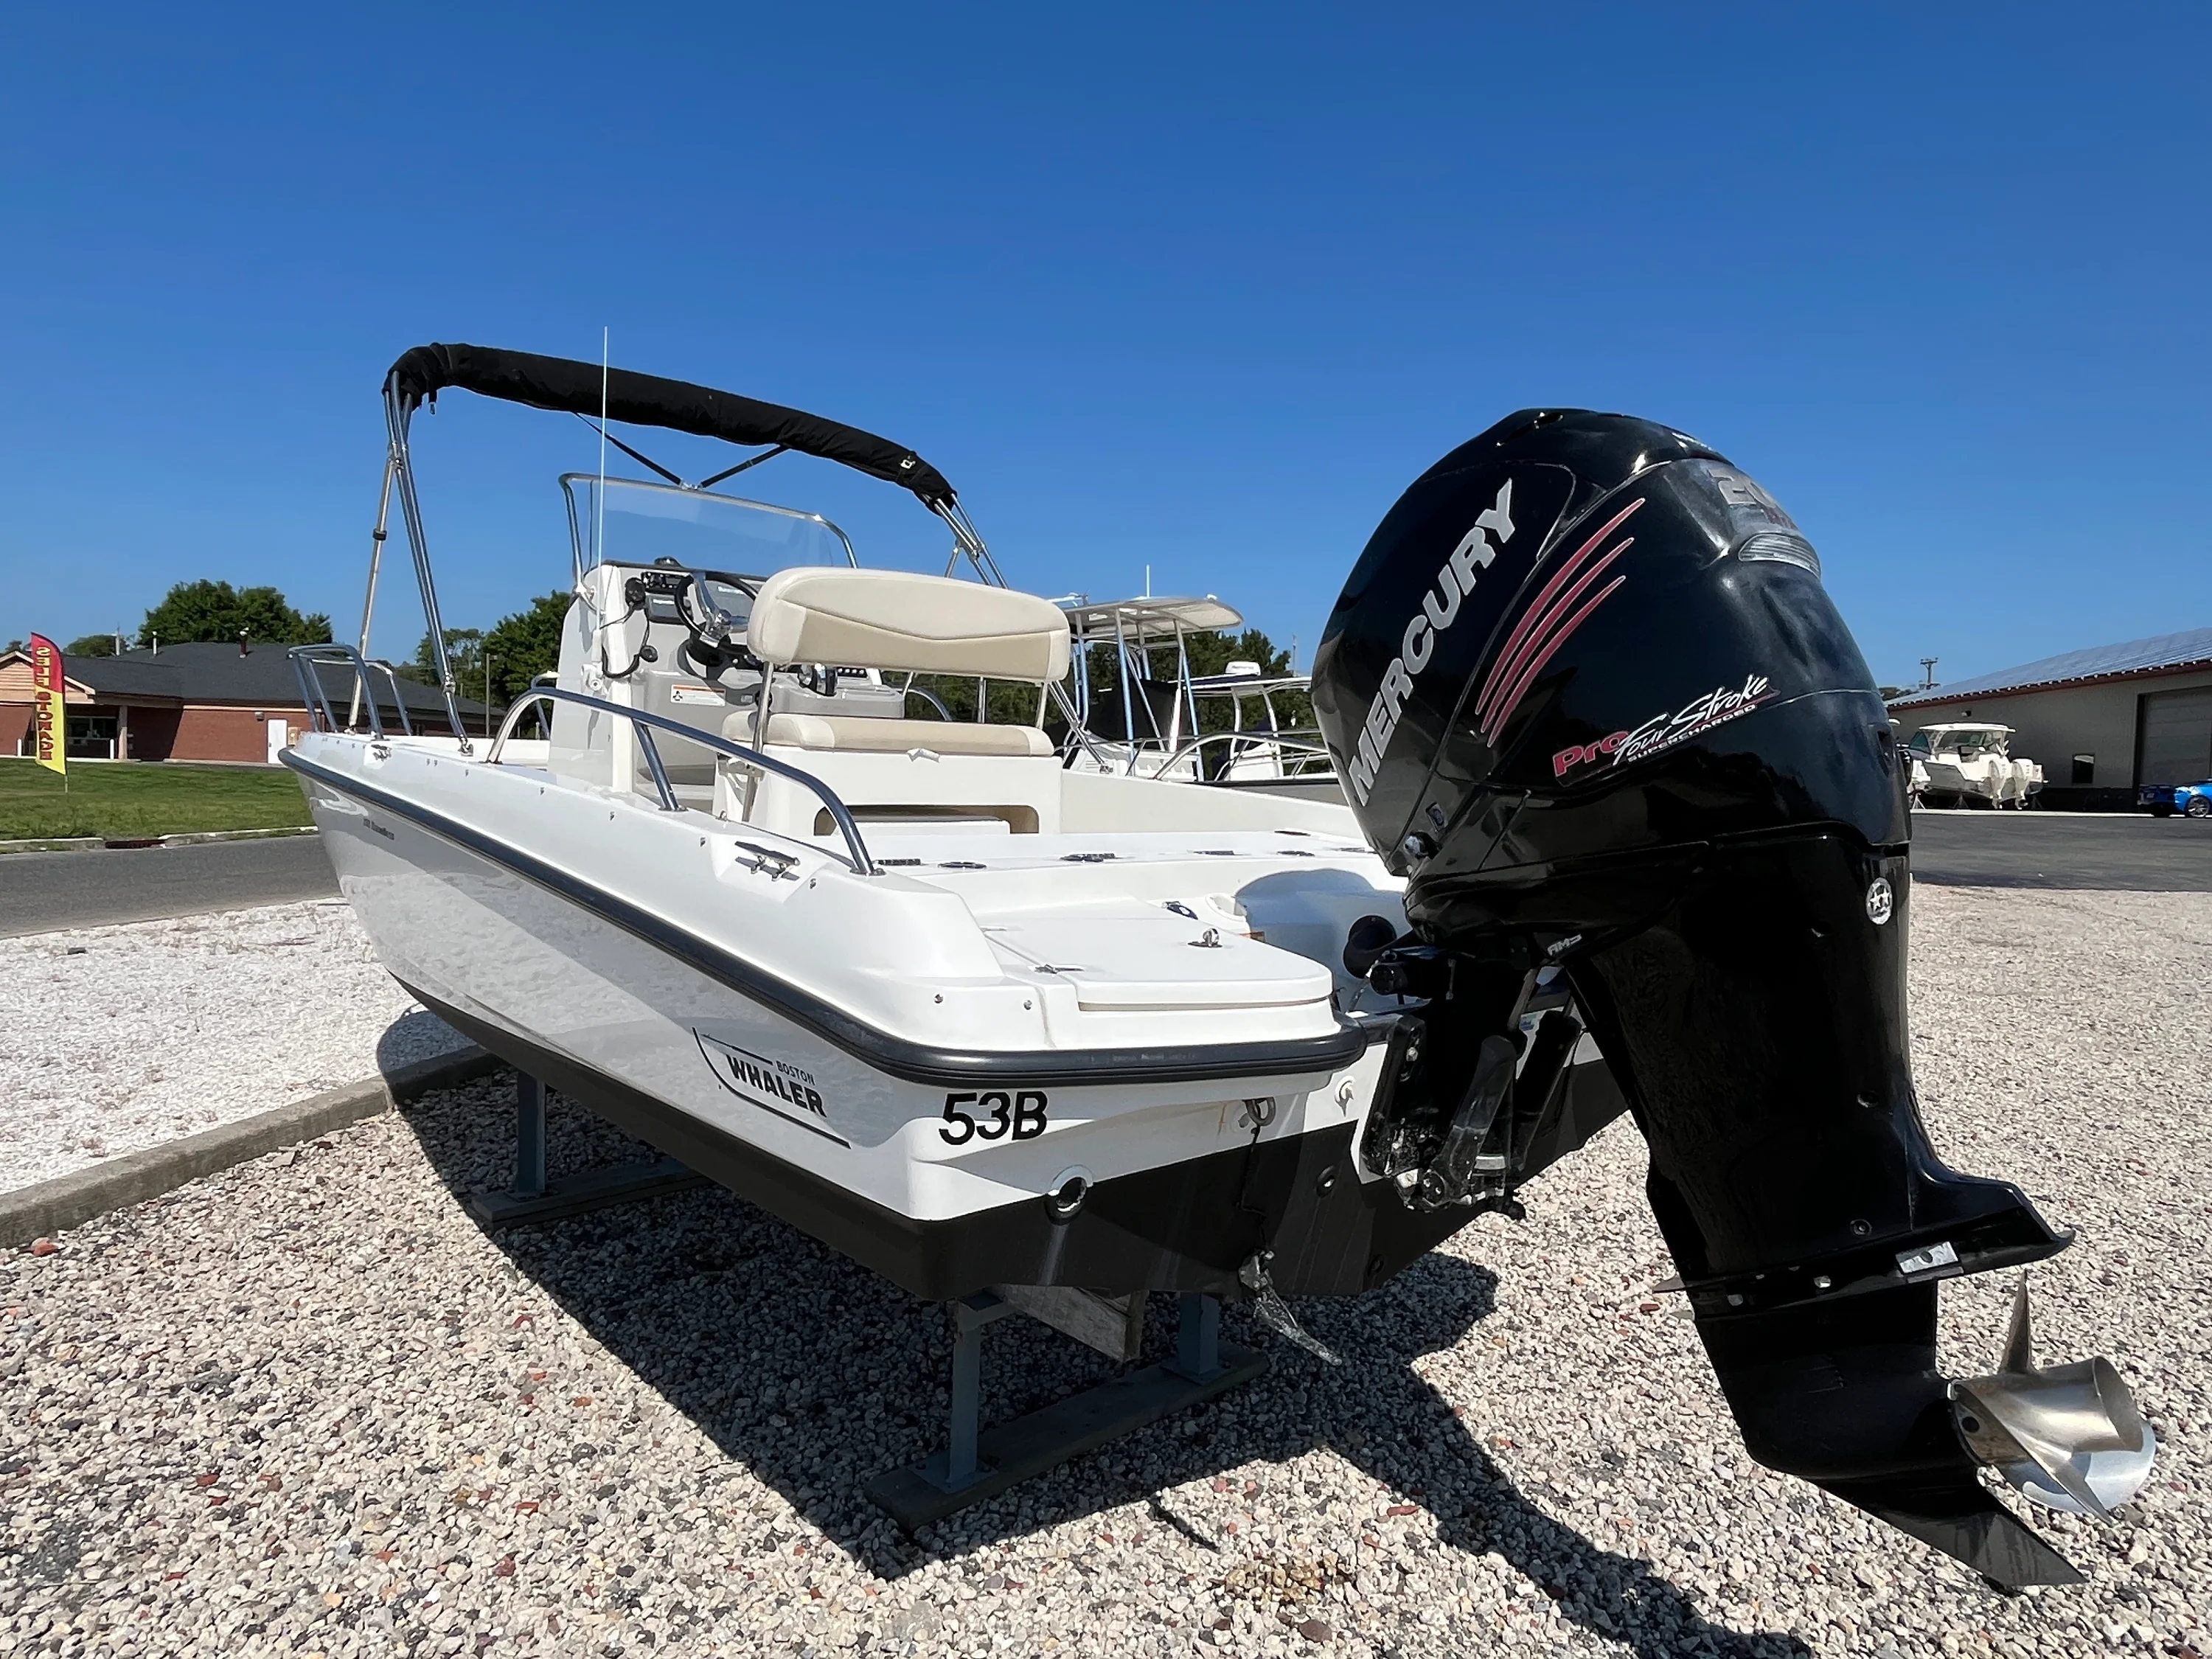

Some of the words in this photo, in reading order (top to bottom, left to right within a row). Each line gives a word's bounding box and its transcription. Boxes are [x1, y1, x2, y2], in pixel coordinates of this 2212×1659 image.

[1349, 477, 1516, 807] MERCURY
[1552, 730, 1630, 777] Pro
[1627, 704, 1756, 762] SUPERCHARGED
[726, 1054, 827, 1118] WHALER
[776, 1060, 815, 1086] BOSTON
[939, 1091, 1048, 1145] 53B
